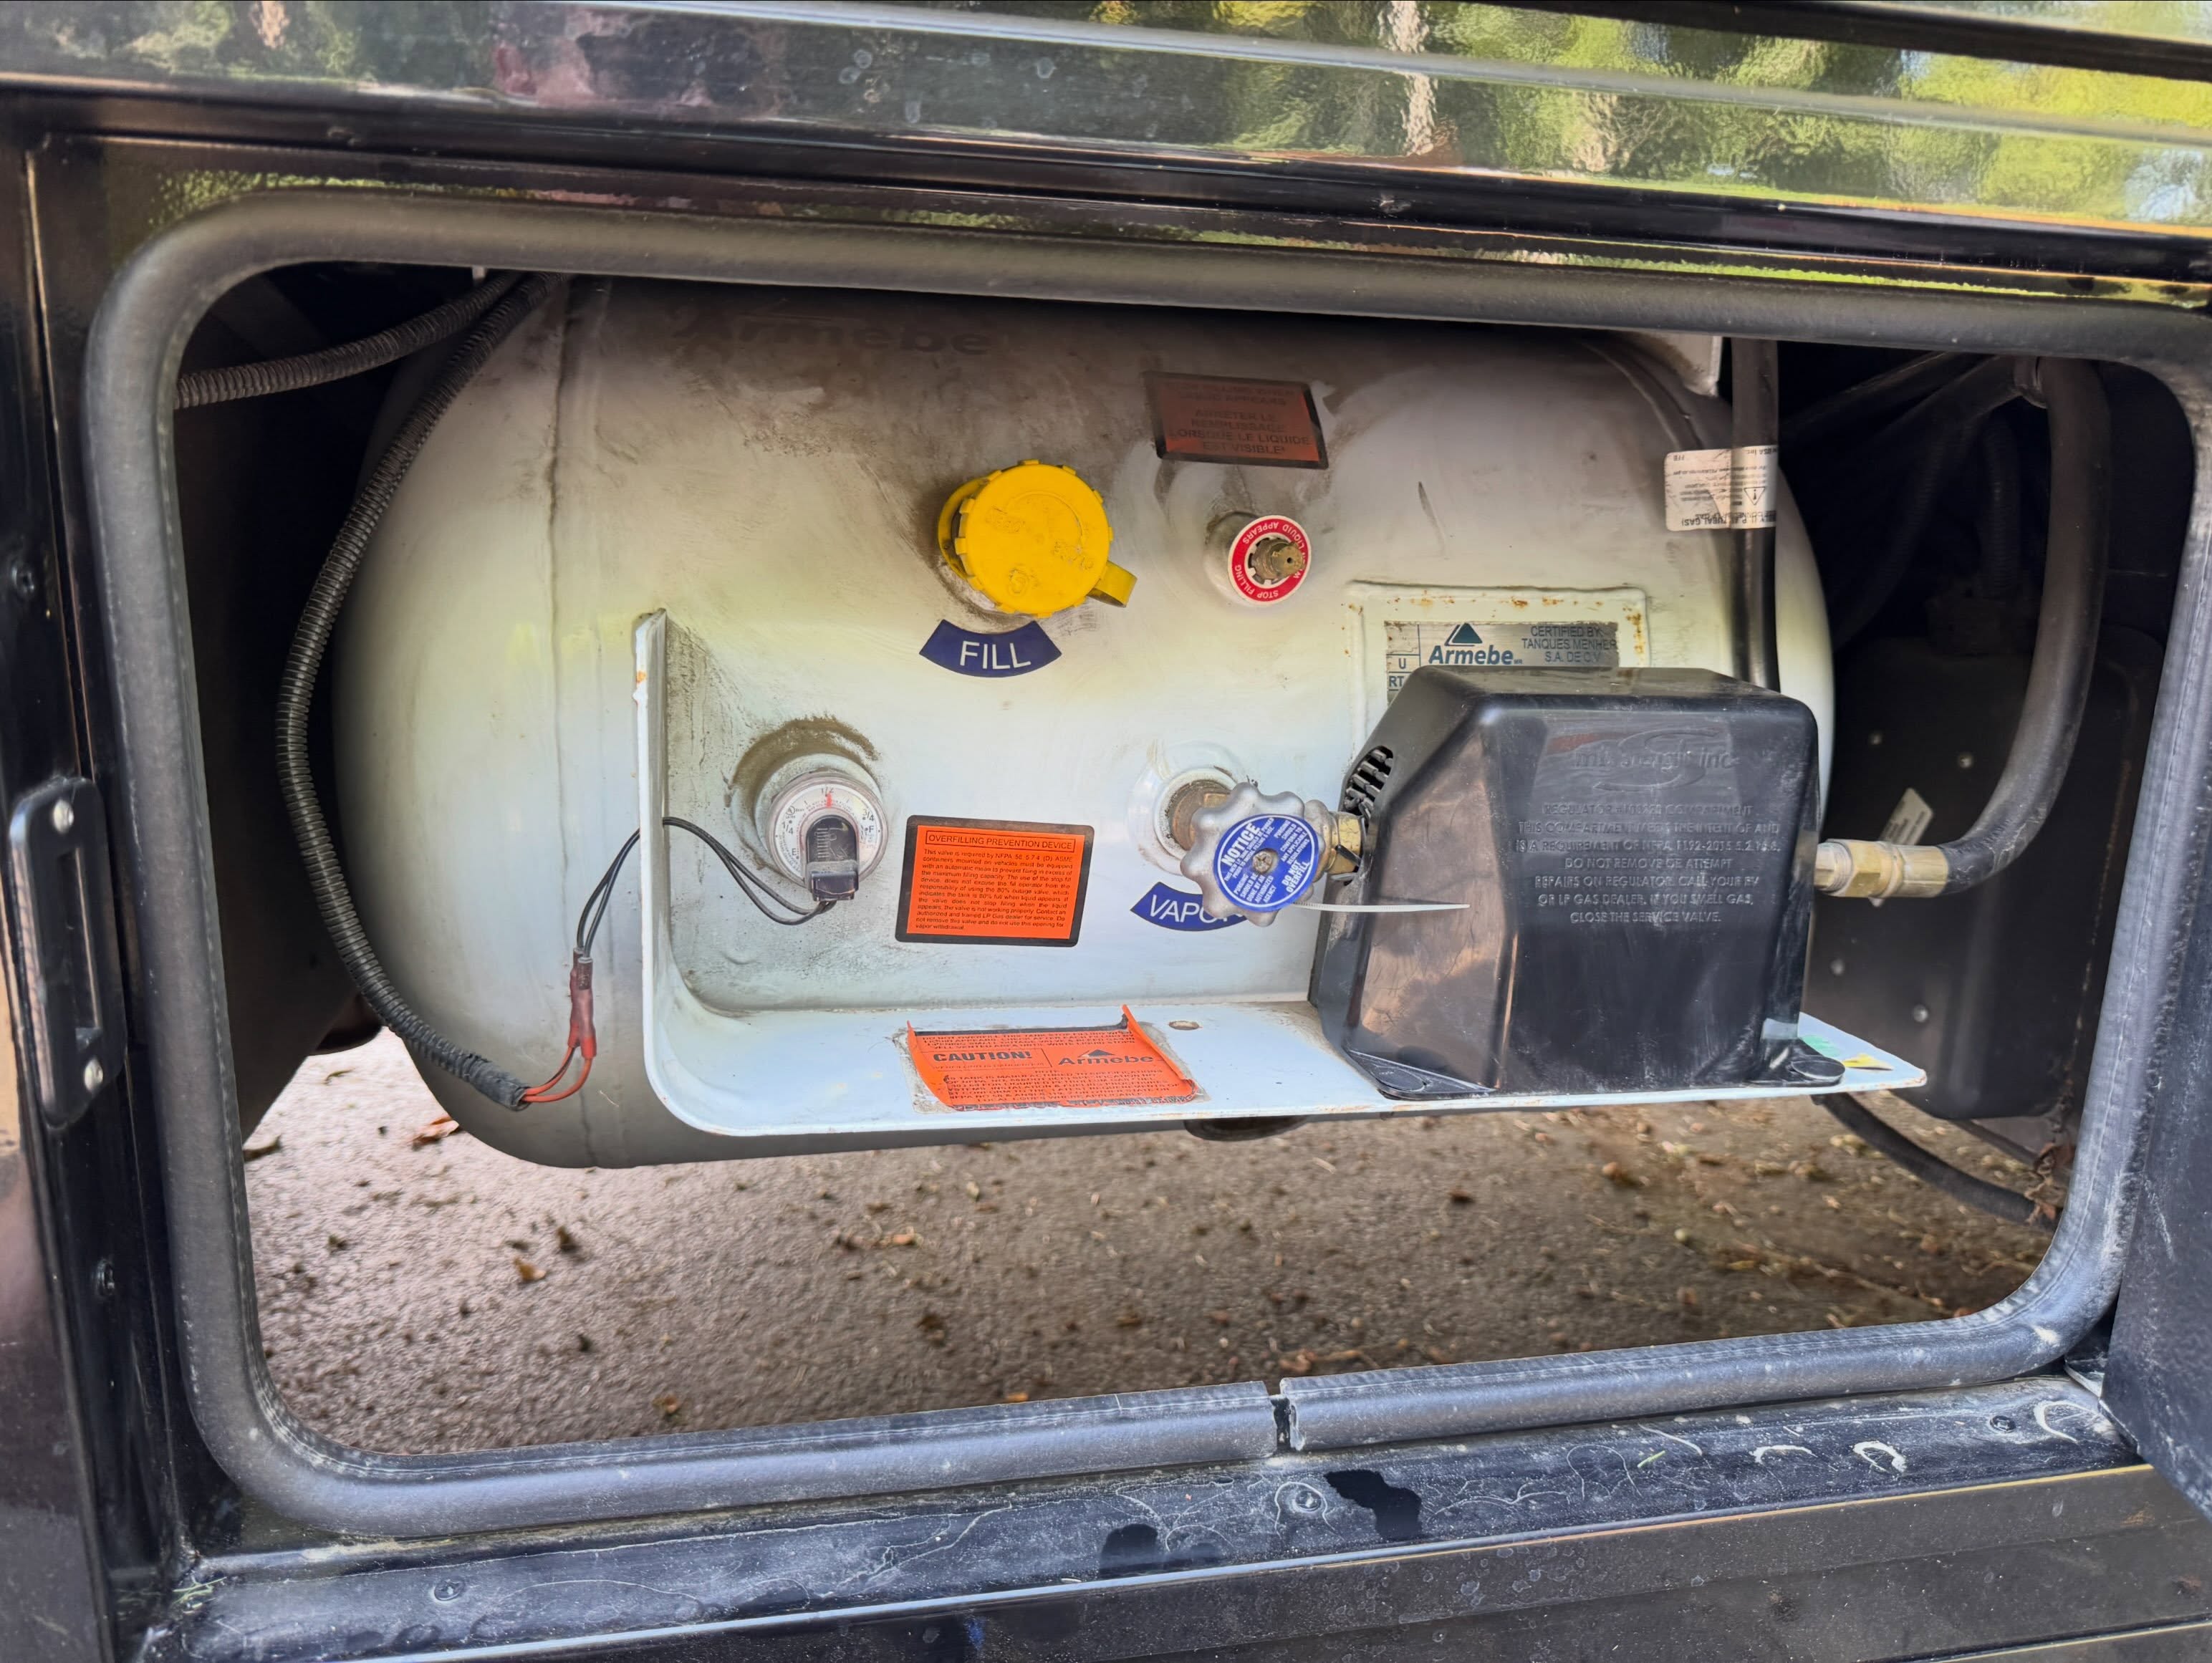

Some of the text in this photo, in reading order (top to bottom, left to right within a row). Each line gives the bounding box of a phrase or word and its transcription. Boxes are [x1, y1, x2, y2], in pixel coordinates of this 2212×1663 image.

[1242, 521, 1305, 550] LIQUID APPEARS
[1234, 564, 1279, 599] STOP FILLING
[1531, 625, 1583, 637] CERTIFIED
[1521, 638, 1570, 650] TANQUES
[960, 640, 1032, 670] FILL
[1398, 657, 1406, 670] U
[1428, 645, 1514, 665] Armebe
[1567, 651, 1581, 662] DE
[1519, 821, 1542, 834] THIS
[1736, 823, 1752, 834] OF
[928, 834, 984, 844] OVERFILLING
[986, 837, 1039, 847] PREVENTION
[1221, 822, 1260, 866] NOTICE
[1279, 830, 1299, 852] CONFORM
[1280, 830, 1307, 862] ANY APPLICABLE
[1516, 839, 1527, 852] IS
[1529, 840, 1538, 852] A
[1565, 857, 1583, 869] DO
[1587, 858, 1611, 869] NOT
[1614, 858, 1663, 869] REMOVE
[1686, 858, 1732, 869] ATTEMPT
[1281, 859, 1302, 887] DO NOT
[1285, 860, 1310, 893] OVERFILL
[1535, 876, 1579, 888] REPAIRS
[1583, 876, 1602, 887] ON
[1678, 875, 1707, 887] CALL
[1710, 876, 1741, 887] YOUR
[1231, 873, 1250, 895] PURGING
[1237, 872, 1259, 898] SHOULD BE
[1245, 874, 1266, 902] DONE BY AN
[1251, 874, 1276, 903] AUTHORIZED
[1261, 884, 1278, 903] AGENCY
[1150, 895, 1243, 923] VAPO
[1539, 895, 1555, 906] OR
[1574, 894, 1600, 905] GAS
[1663, 894, 1686, 905] YOU
[1691, 894, 1723, 905] SMELL
[1570, 912, 1607, 923] CLOSE
[1610, 912, 1630, 922] THE
[1632, 912, 1679, 922] SERVICE
[933, 1050, 1032, 1062] CAUTION!
[1058, 1055, 1154, 1066] Armebe
